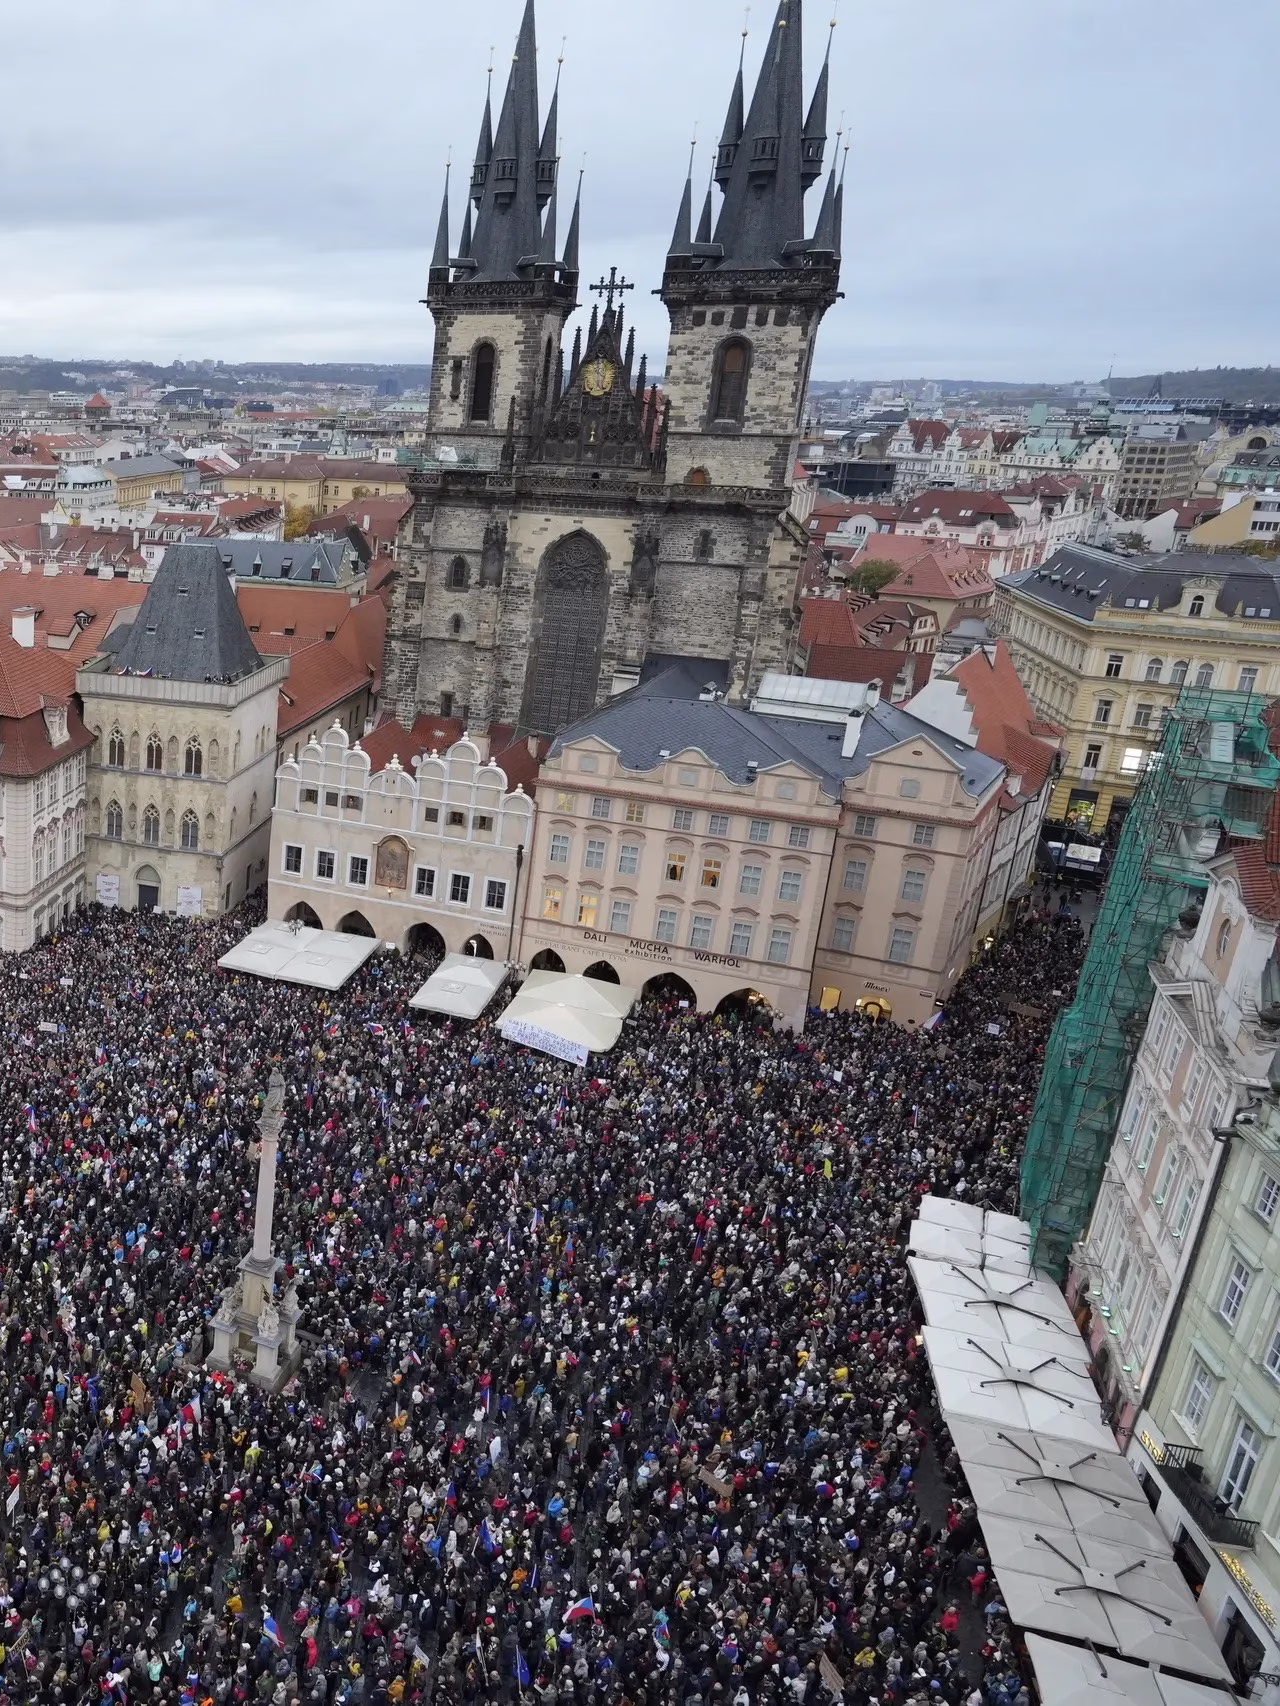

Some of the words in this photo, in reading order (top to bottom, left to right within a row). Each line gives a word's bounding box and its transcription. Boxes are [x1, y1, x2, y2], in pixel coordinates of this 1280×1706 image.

[629, 940, 669, 955] MUCHA
[624, 948, 673, 962] exhibition
[694, 951, 741, 969] WARHOL
[864, 981, 891, 993] Moser
